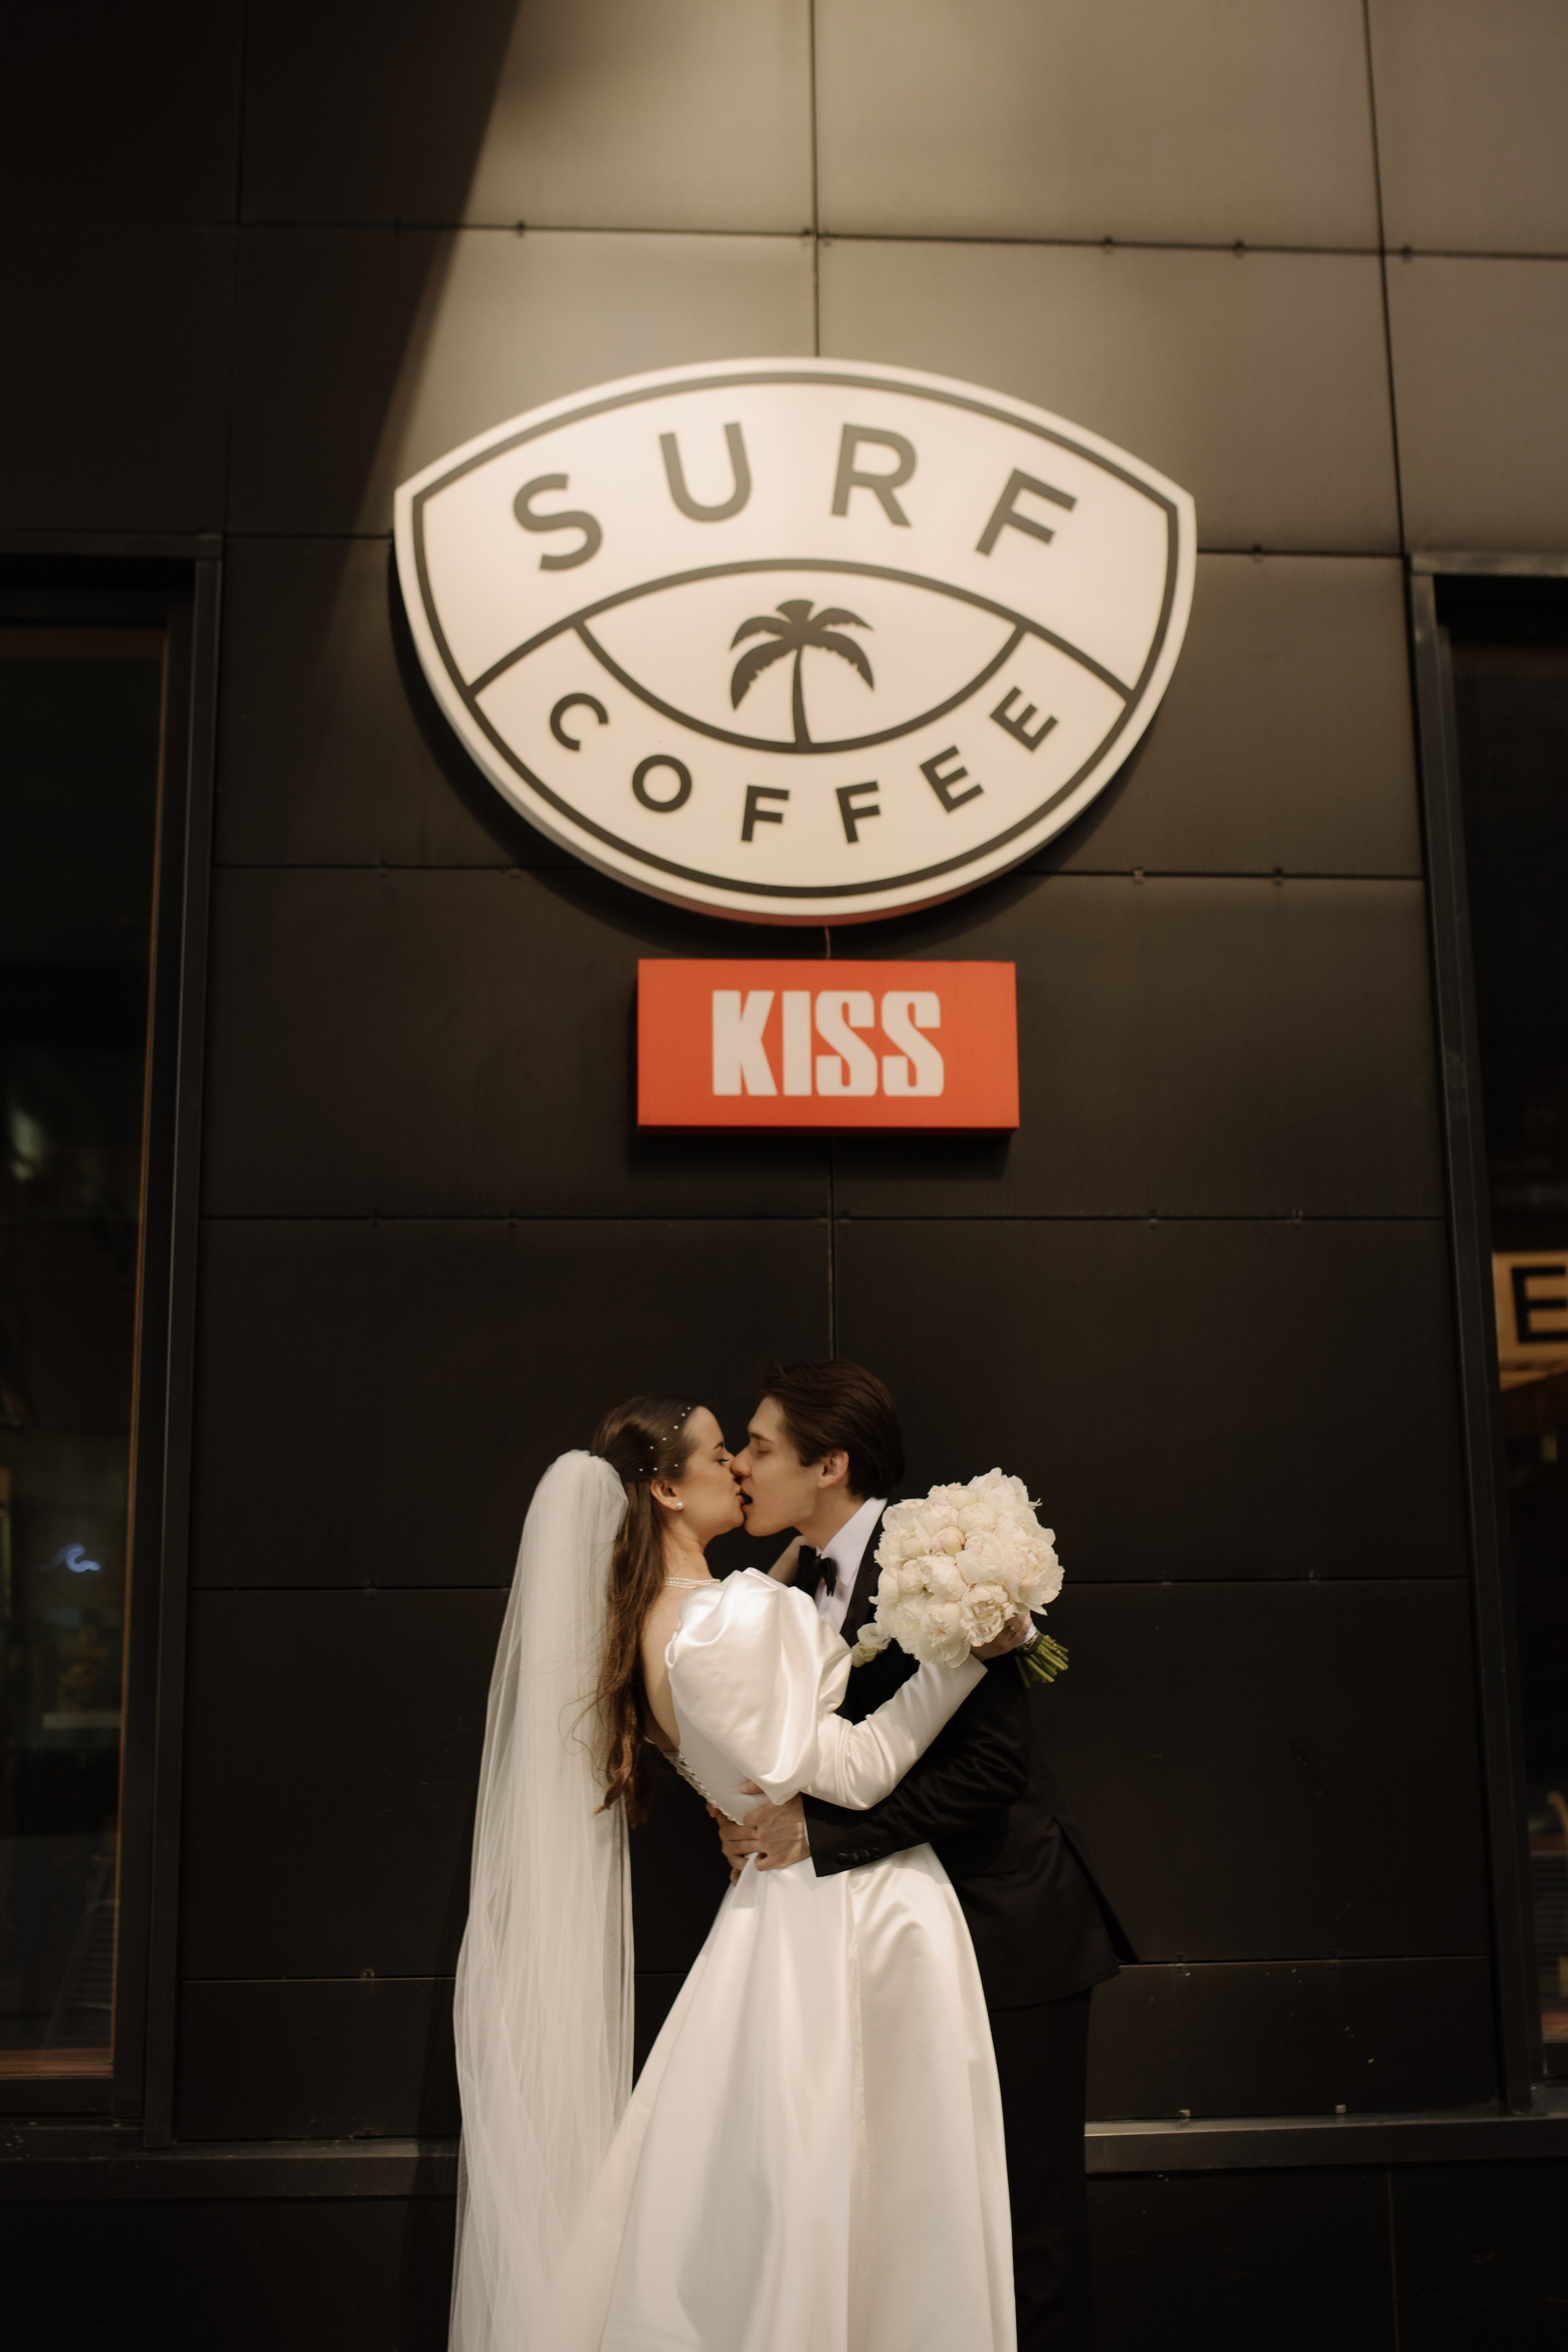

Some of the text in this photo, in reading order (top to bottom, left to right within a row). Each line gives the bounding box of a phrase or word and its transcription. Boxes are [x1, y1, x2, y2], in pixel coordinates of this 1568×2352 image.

[512, 421, 1078, 572] SURF
[548, 686, 1060, 845] COFFEE
[712, 990, 945, 1096] KISS
